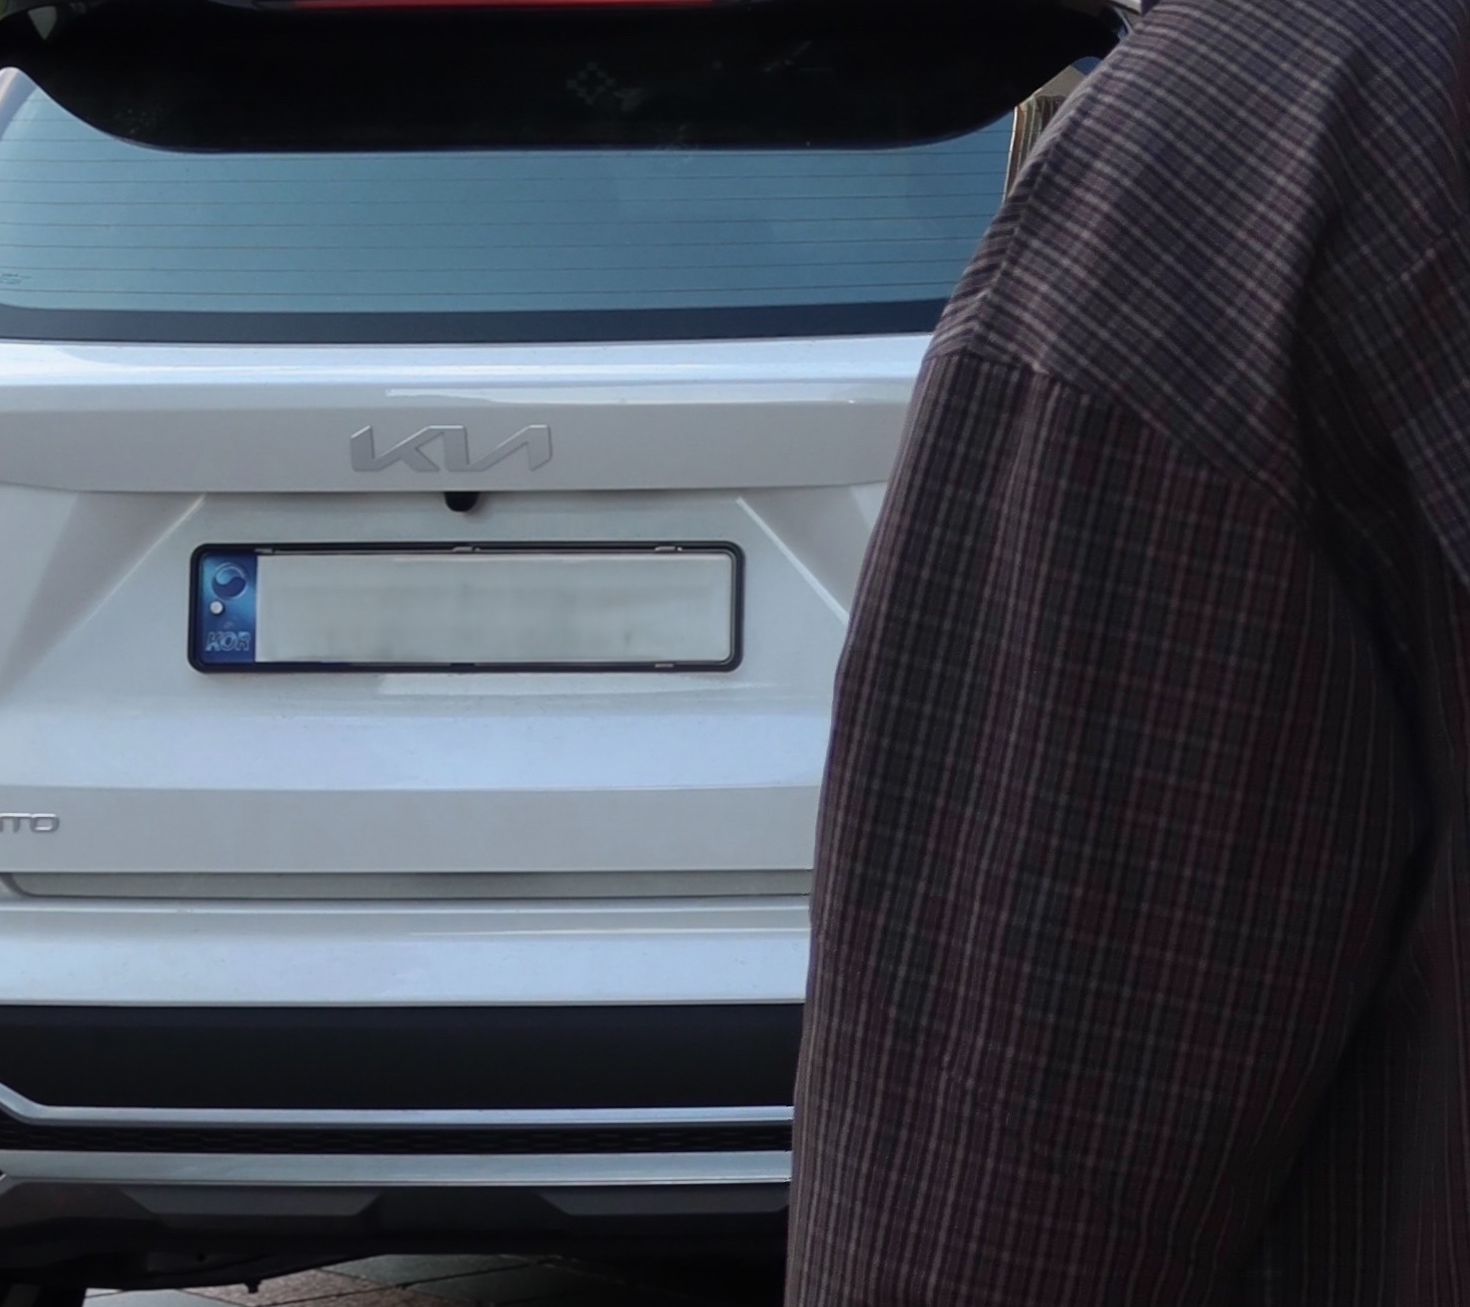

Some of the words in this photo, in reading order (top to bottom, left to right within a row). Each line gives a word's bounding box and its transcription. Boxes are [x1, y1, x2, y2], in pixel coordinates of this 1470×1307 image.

[350, 424, 553, 473] KIA
[205, 630, 251, 652] KOR
[0, 812, 60, 833] TO
